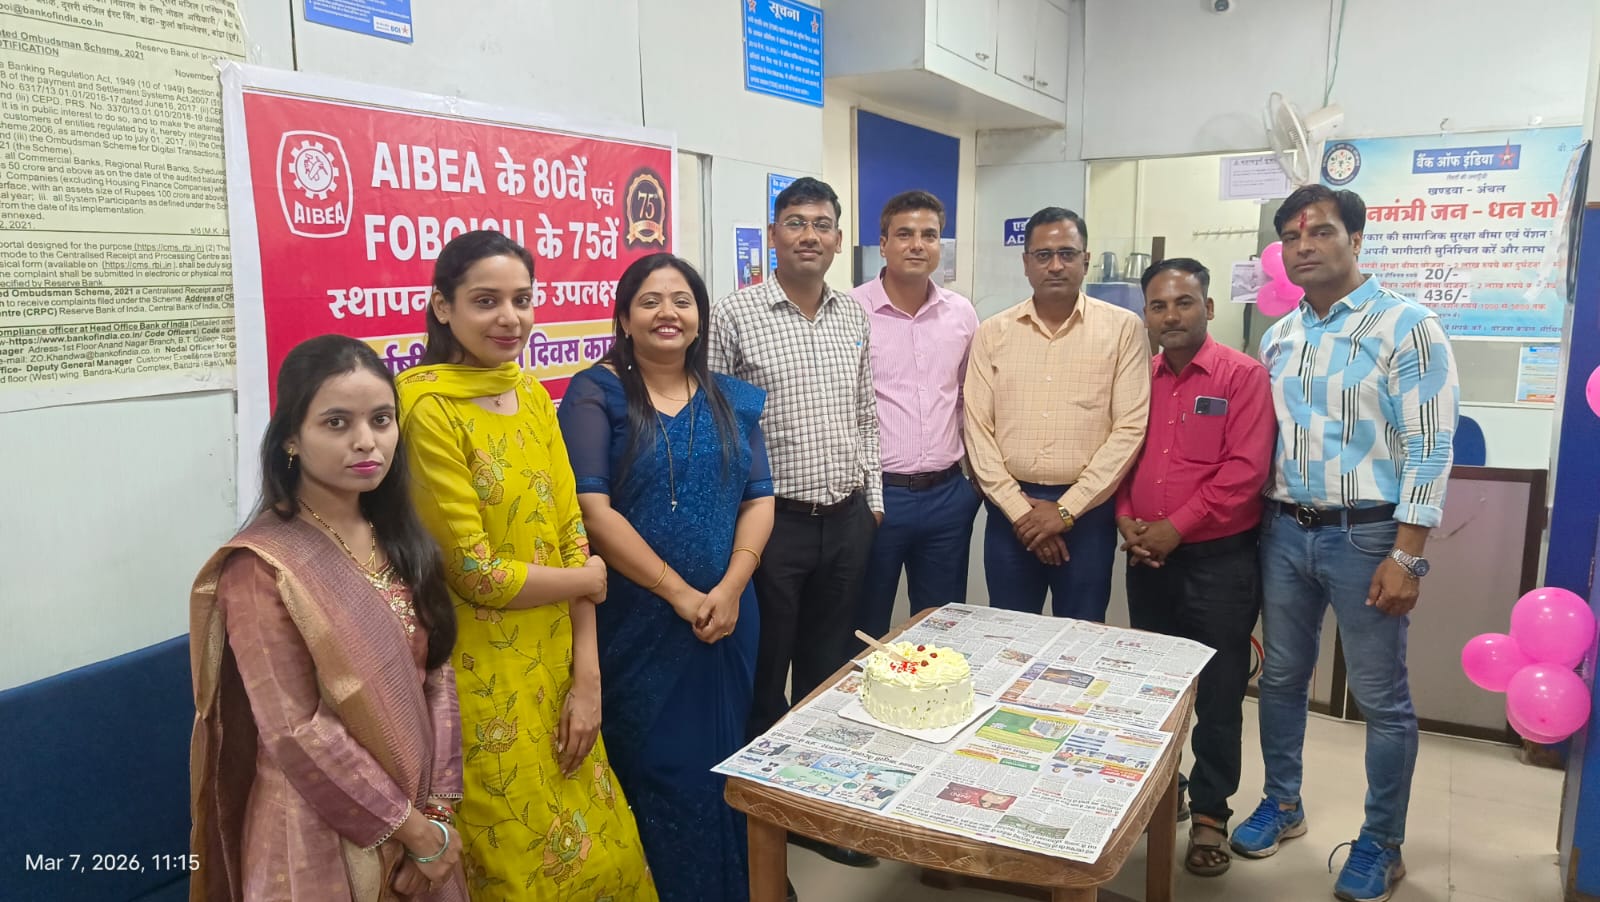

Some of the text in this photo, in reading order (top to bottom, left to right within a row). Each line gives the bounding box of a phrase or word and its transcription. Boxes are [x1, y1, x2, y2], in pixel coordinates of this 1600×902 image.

[768, 0, 800, 22] सूचना
[21, 32, 81, 49] Ombudsman
[136, 42, 168, 54] Reserve
[8, 61, 45, 75] Banking
[48, 67, 94, 80] Regulation
[175, 69, 214, 81] November
[37, 76, 76, 88] payment
[3, 112, 51, 123] customers
[46, 135, 100, 147] Ombudsman
[18, 152, 71, 164] Commercial
[105, 159, 142, 170] Regional
[1416, 151, 1494, 168] बैंक ऑफ इंडिया
[8, 162, 20, 170] 50
[66, 167, 92, 175] above
[6, 171, 58, 182] Companies
[60, 176, 104, 187] (excluding
[371, 142, 614, 210] AIBEA के 80वें एवं
[64, 194, 97, 203] System
[294, 200, 346, 224] AIBEA
[1366, 198, 1426, 222] नमंत्री
[1431, 204, 1468, 220] जन
[1488, 202, 1526, 219] धन
[1531, 194, 1558, 218] यो
[535, 213, 564, 260] के
[568, 216, 620, 260] 75वें
[1387, 231, 1398, 240] की
[27, 241, 68, 250] designed
[1501, 244, 1519, 254] और
[1425, 268, 1458, 282] 20/-
[12, 289, 72, 297] Ombudsman
[1424, 289, 1467, 304] 436/-
[51, 298, 96, 306] complaints
[326, 286, 432, 319] स्थापन
[23, 308, 57, 317] (CRPC)
[49, 327, 78, 335] officer
[113, 323, 138, 331] Office
[529, 332, 580, 367] दिवस
[26, 364, 58, 373] Deputy
[61, 360, 94, 369] General
[97, 358, 132, 366] Manager
[29, 372, 58, 382] (West)
